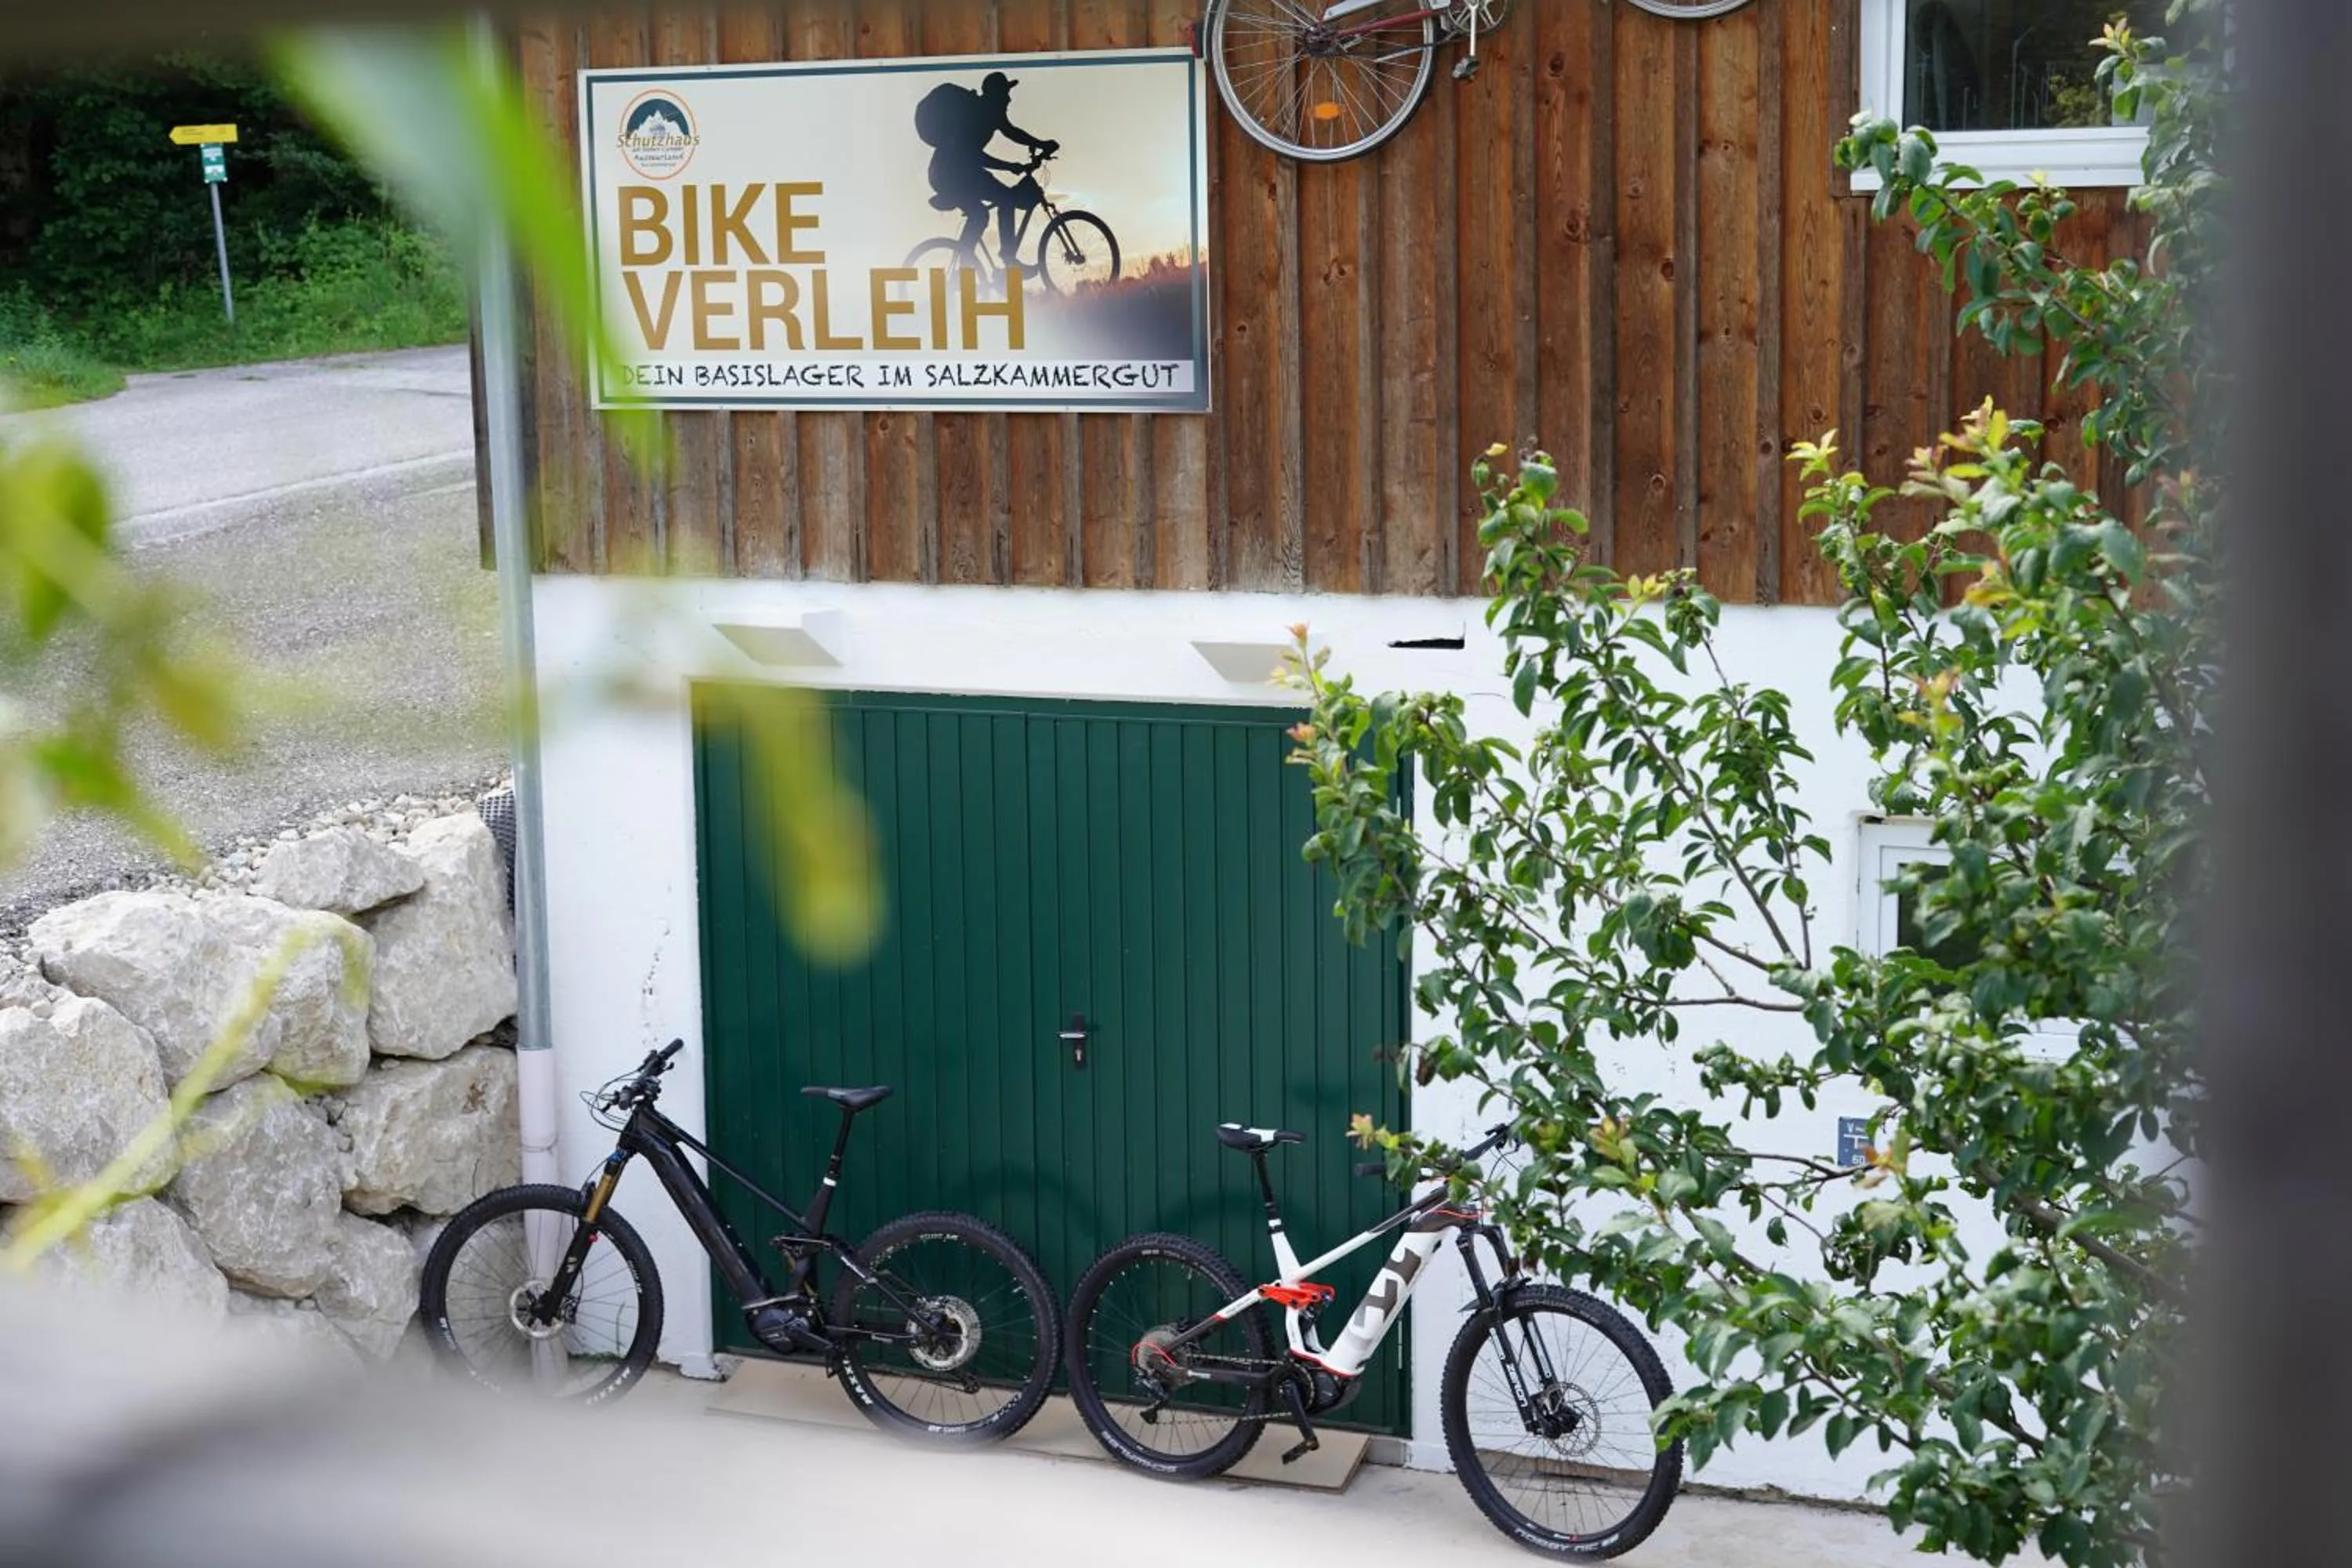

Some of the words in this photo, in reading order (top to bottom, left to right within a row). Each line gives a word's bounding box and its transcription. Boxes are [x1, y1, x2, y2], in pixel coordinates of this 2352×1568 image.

[617, 181, 826, 267] BIKE
[622, 267, 1025, 351] VERLEIH
[619, 364, 684, 387] DEIN
[695, 364, 865, 388] BASISLAGER
[878, 365, 913, 387] IM
[925, 362, 1180, 389] SALZKAMMERGUT
